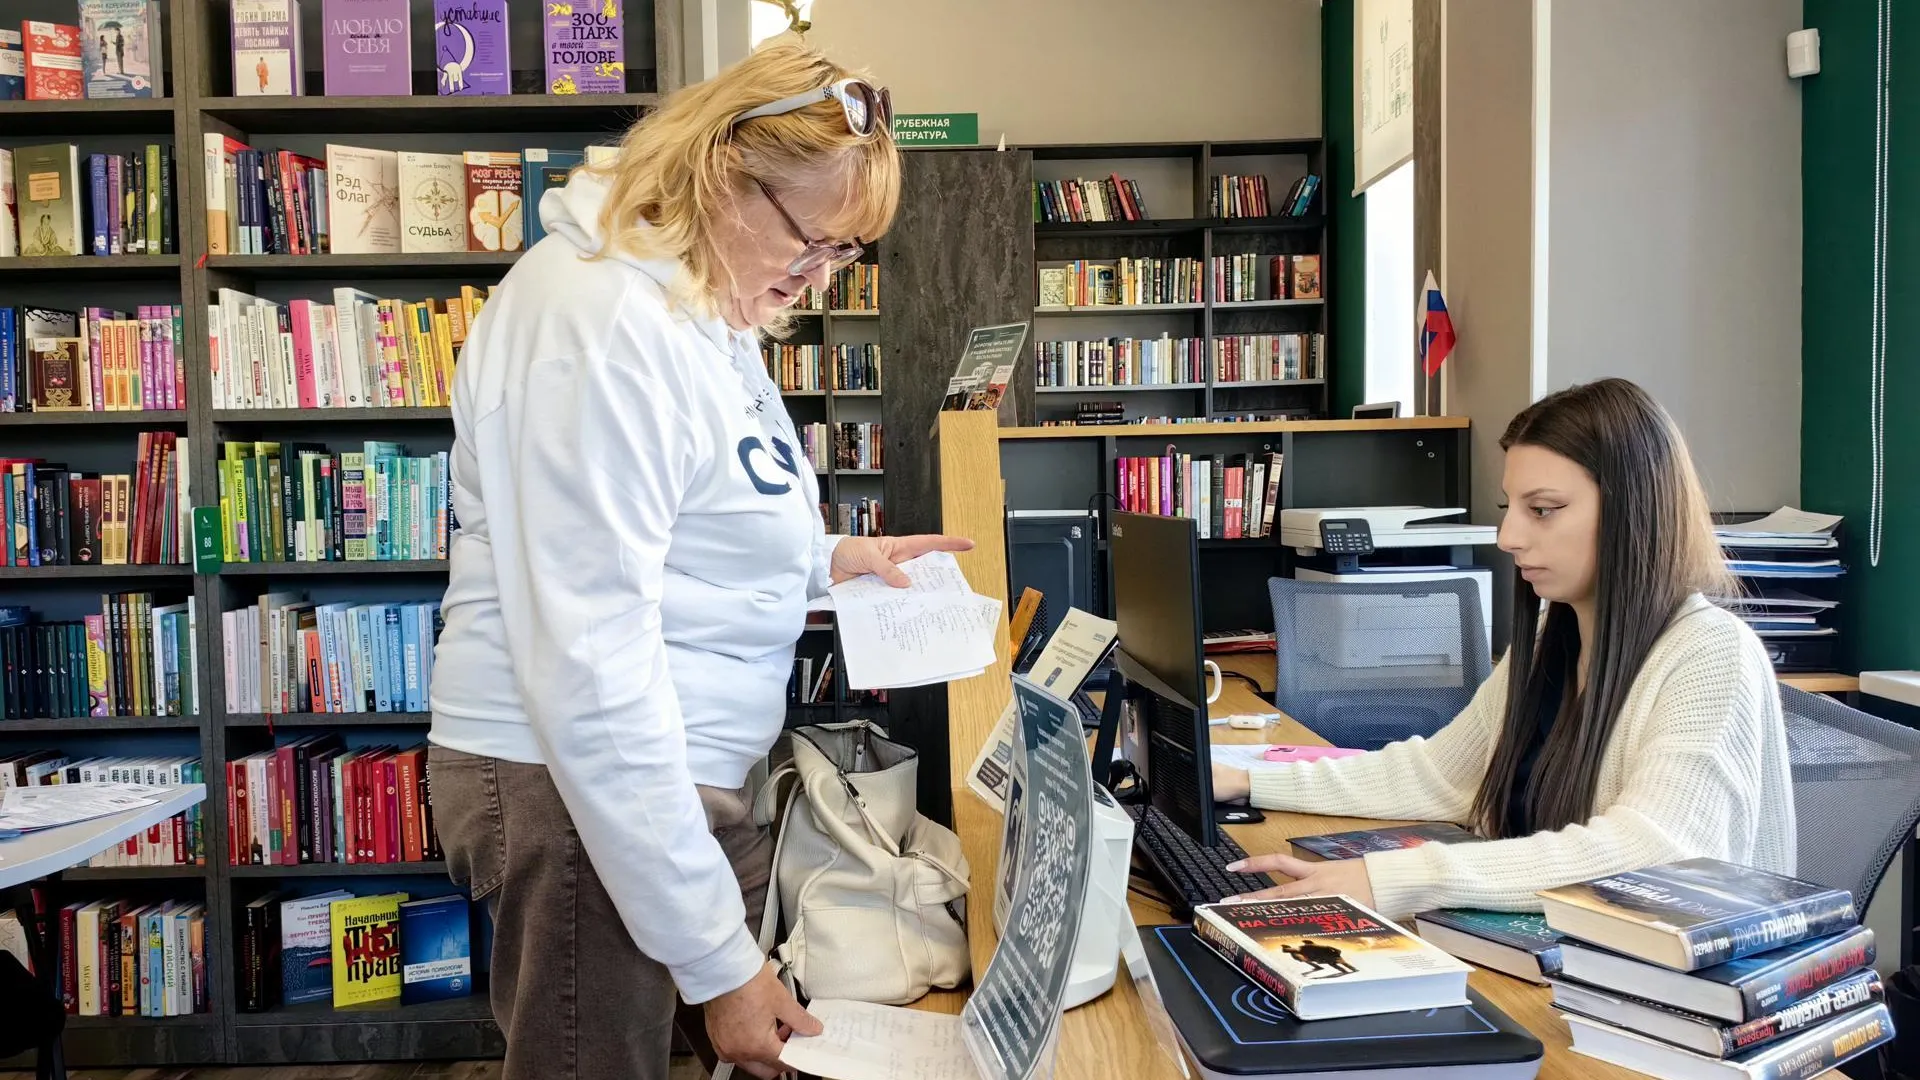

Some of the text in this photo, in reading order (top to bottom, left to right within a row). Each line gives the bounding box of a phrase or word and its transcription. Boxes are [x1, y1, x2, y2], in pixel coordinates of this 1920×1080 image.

[261, 10, 287, 22] ШАРМА
[440, 2, 501, 36] уставшие
[572, 13, 608, 26] ЗОО
[234, 25, 289, 38] ДЕВЯТЬ ТАЙНЫХ
[331, 18, 403, 35] ЛЮБЛЮ
[572, 26, 618, 40] ПАРК
[244, 37, 280, 48] ПОСЛАНИЙ
[343, 38, 391, 54] СЕБЯ
[559, 41, 584, 49] твоей
[552, 50, 616, 64] ГОЛОВЕ
[894, 118, 950, 128] РУБЕЖНАЯ
[894, 131, 948, 140] ИТЕРАТУРА
[336, 173, 362, 190] Рэд
[471, 168, 521, 179] МОЗГ РЕБЁНК
[336, 188, 371, 204] Флаг
[408, 226, 453, 237] СУДЬБА
[447, 303, 459, 338] ШАРМА
[284, 475, 292, 495] КОДЕКС
[237, 478, 245, 519] подросток!
[407, 643, 418, 690] РЕБЕНОК
[403, 765, 412, 818] ПСИХОЛОГИЯ
[1225, 903, 1345, 918] ГЭЛБРЕЙТ
[1231, 903, 1288, 912] РОБЕРТ
[1238, 913, 1350, 929] НА СЛУЖБЕ
[1317, 918, 1380, 933] ЗЛА
[1760, 911, 1808, 944] ГРИШЭМ
[1205, 923, 1240, 957] ГЭЛБРЕЙТ
[1693, 936, 1731, 957] СЕРАЯ ГОРА
[165, 944, 174, 988] ТАЙСКИЙ
[347, 954, 400, 983] прав
[1243, 953, 1258, 976] ЗЛА
[1814, 946, 1866, 981] ЖАН-КРИСТОФ
[83, 965, 91, 992] МАСЛО
[1833, 981, 1871, 1011] ПИТЕР
[1775, 991, 1832, 1031] ДЖЕЙМС
[1736, 1024, 1776, 1047] Призраки
[1832, 1025, 1867, 1058] КУКУШКИ
[1777, 1043, 1824, 1077] ГЭЛБРЕЙТ
